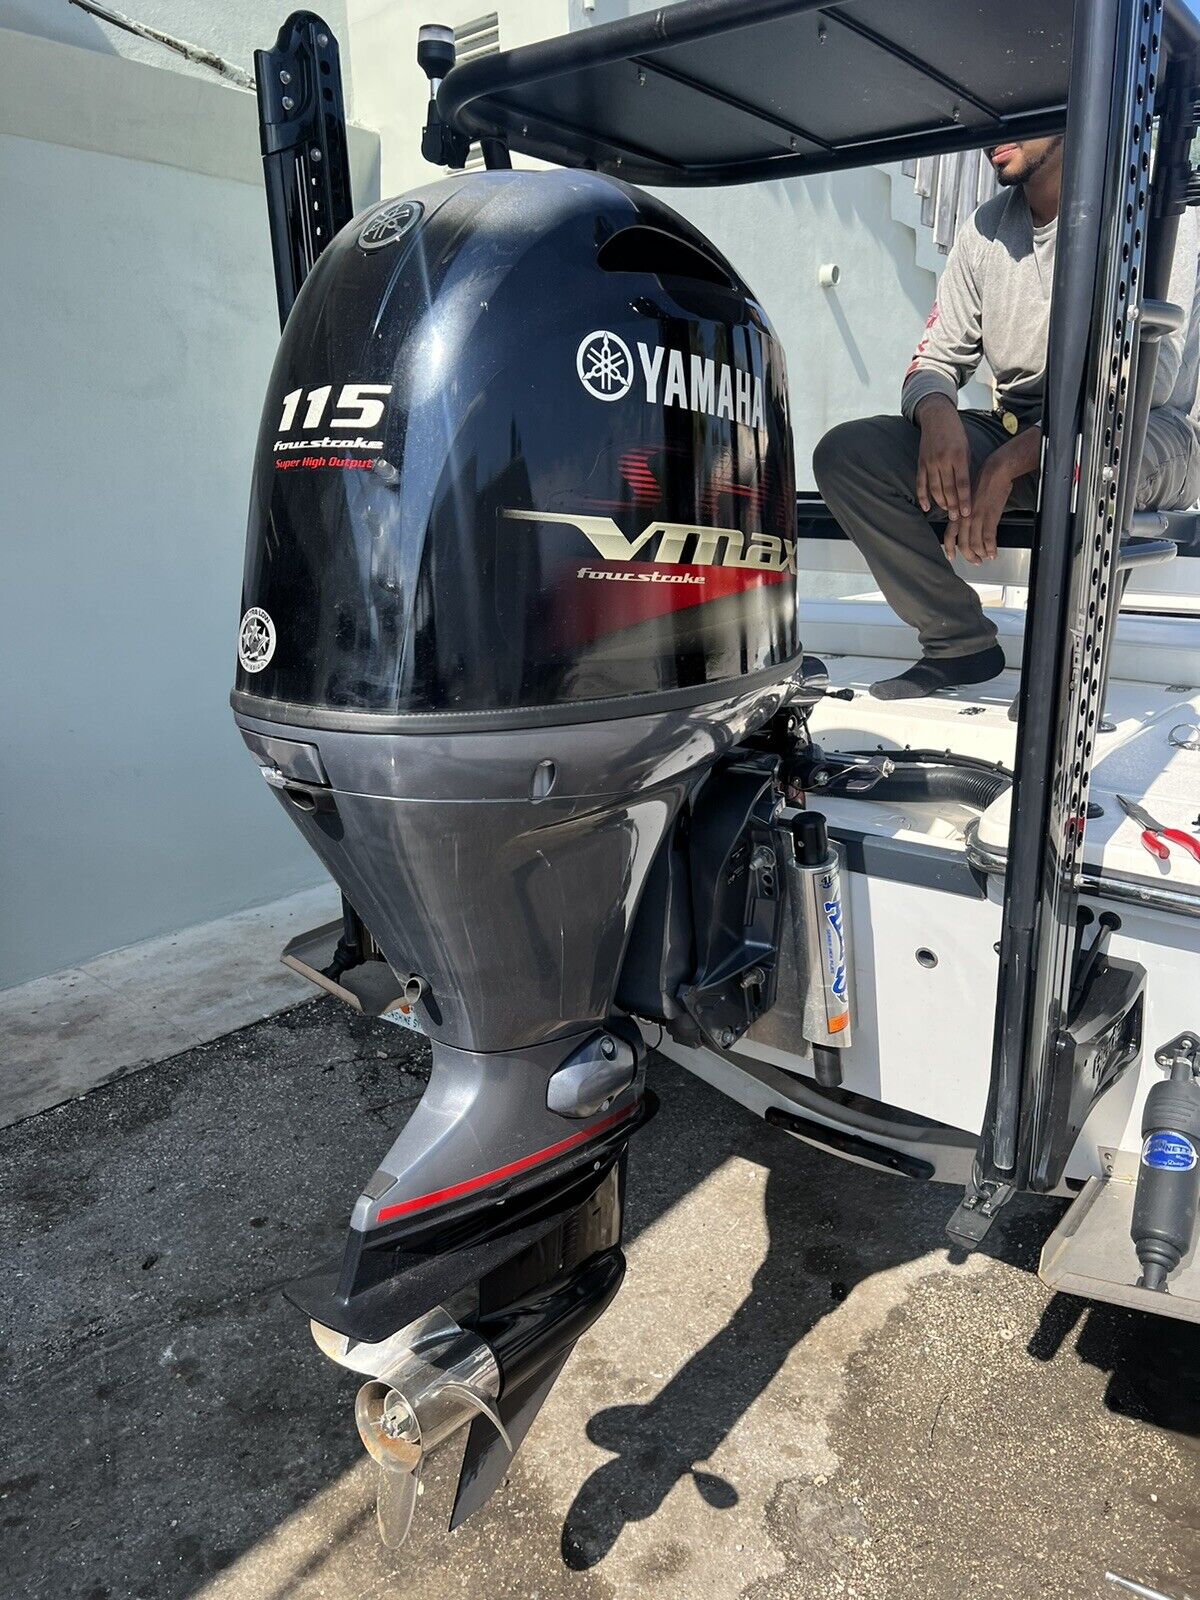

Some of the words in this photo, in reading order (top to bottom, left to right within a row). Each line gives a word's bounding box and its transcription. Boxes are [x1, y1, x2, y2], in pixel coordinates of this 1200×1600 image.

[278, 384, 393, 432] 115
[636, 341, 765, 430] YAMAHA
[275, 459, 300, 470] Super
[302, 457, 325, 469] High
[328, 456, 373, 471] Output
